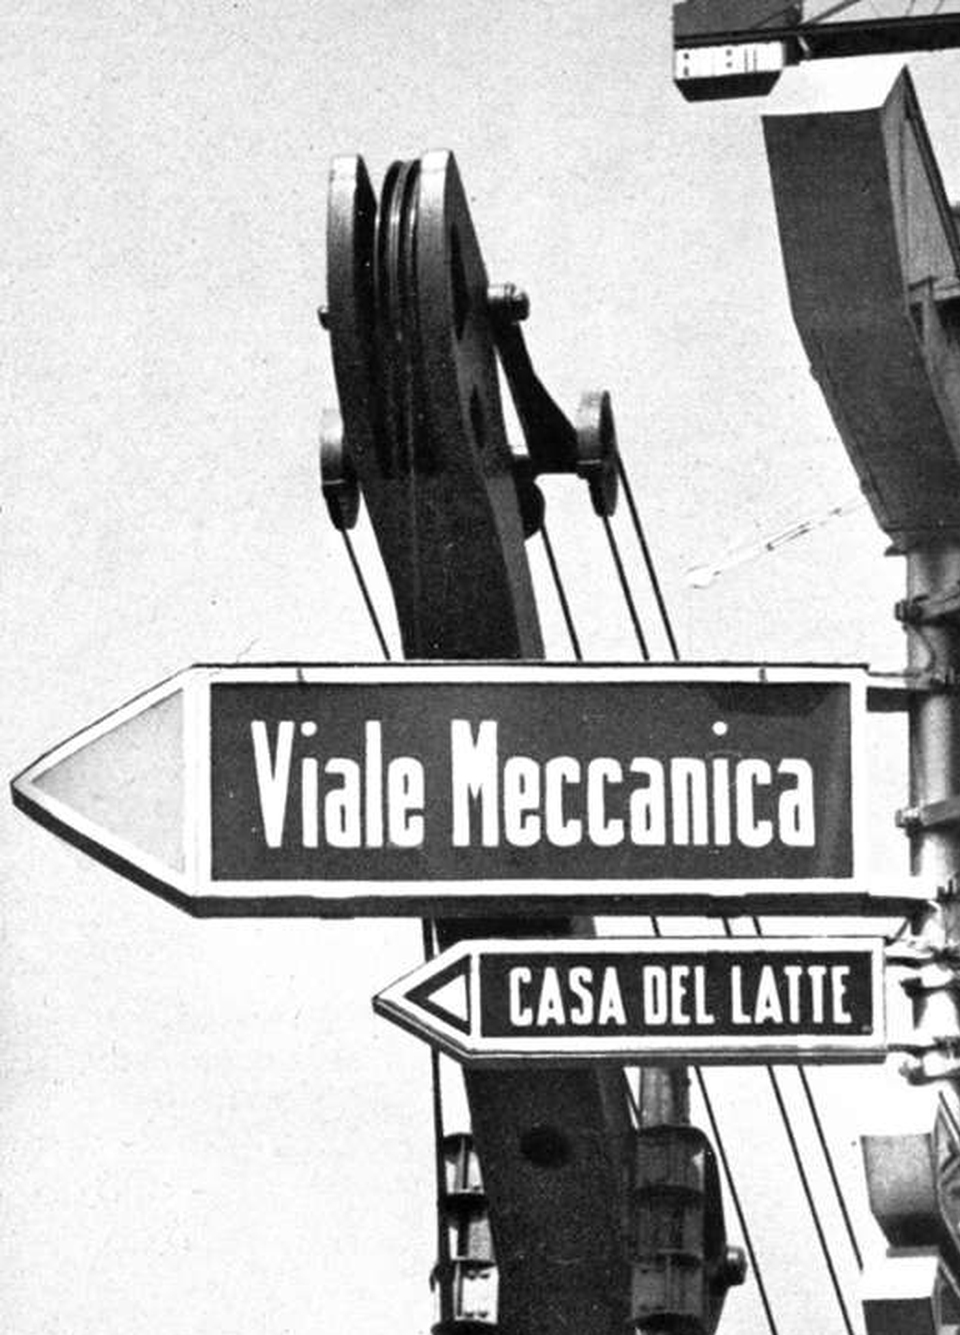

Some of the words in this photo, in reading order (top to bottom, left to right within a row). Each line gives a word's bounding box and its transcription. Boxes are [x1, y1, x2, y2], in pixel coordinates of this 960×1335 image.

[250, 719, 426, 849] Viale
[450, 718, 816, 848] Meccanica
[509, 966, 627, 1027] CASA
[643, 965, 715, 1025] DEL
[731, 965, 852, 1025] LATTE
